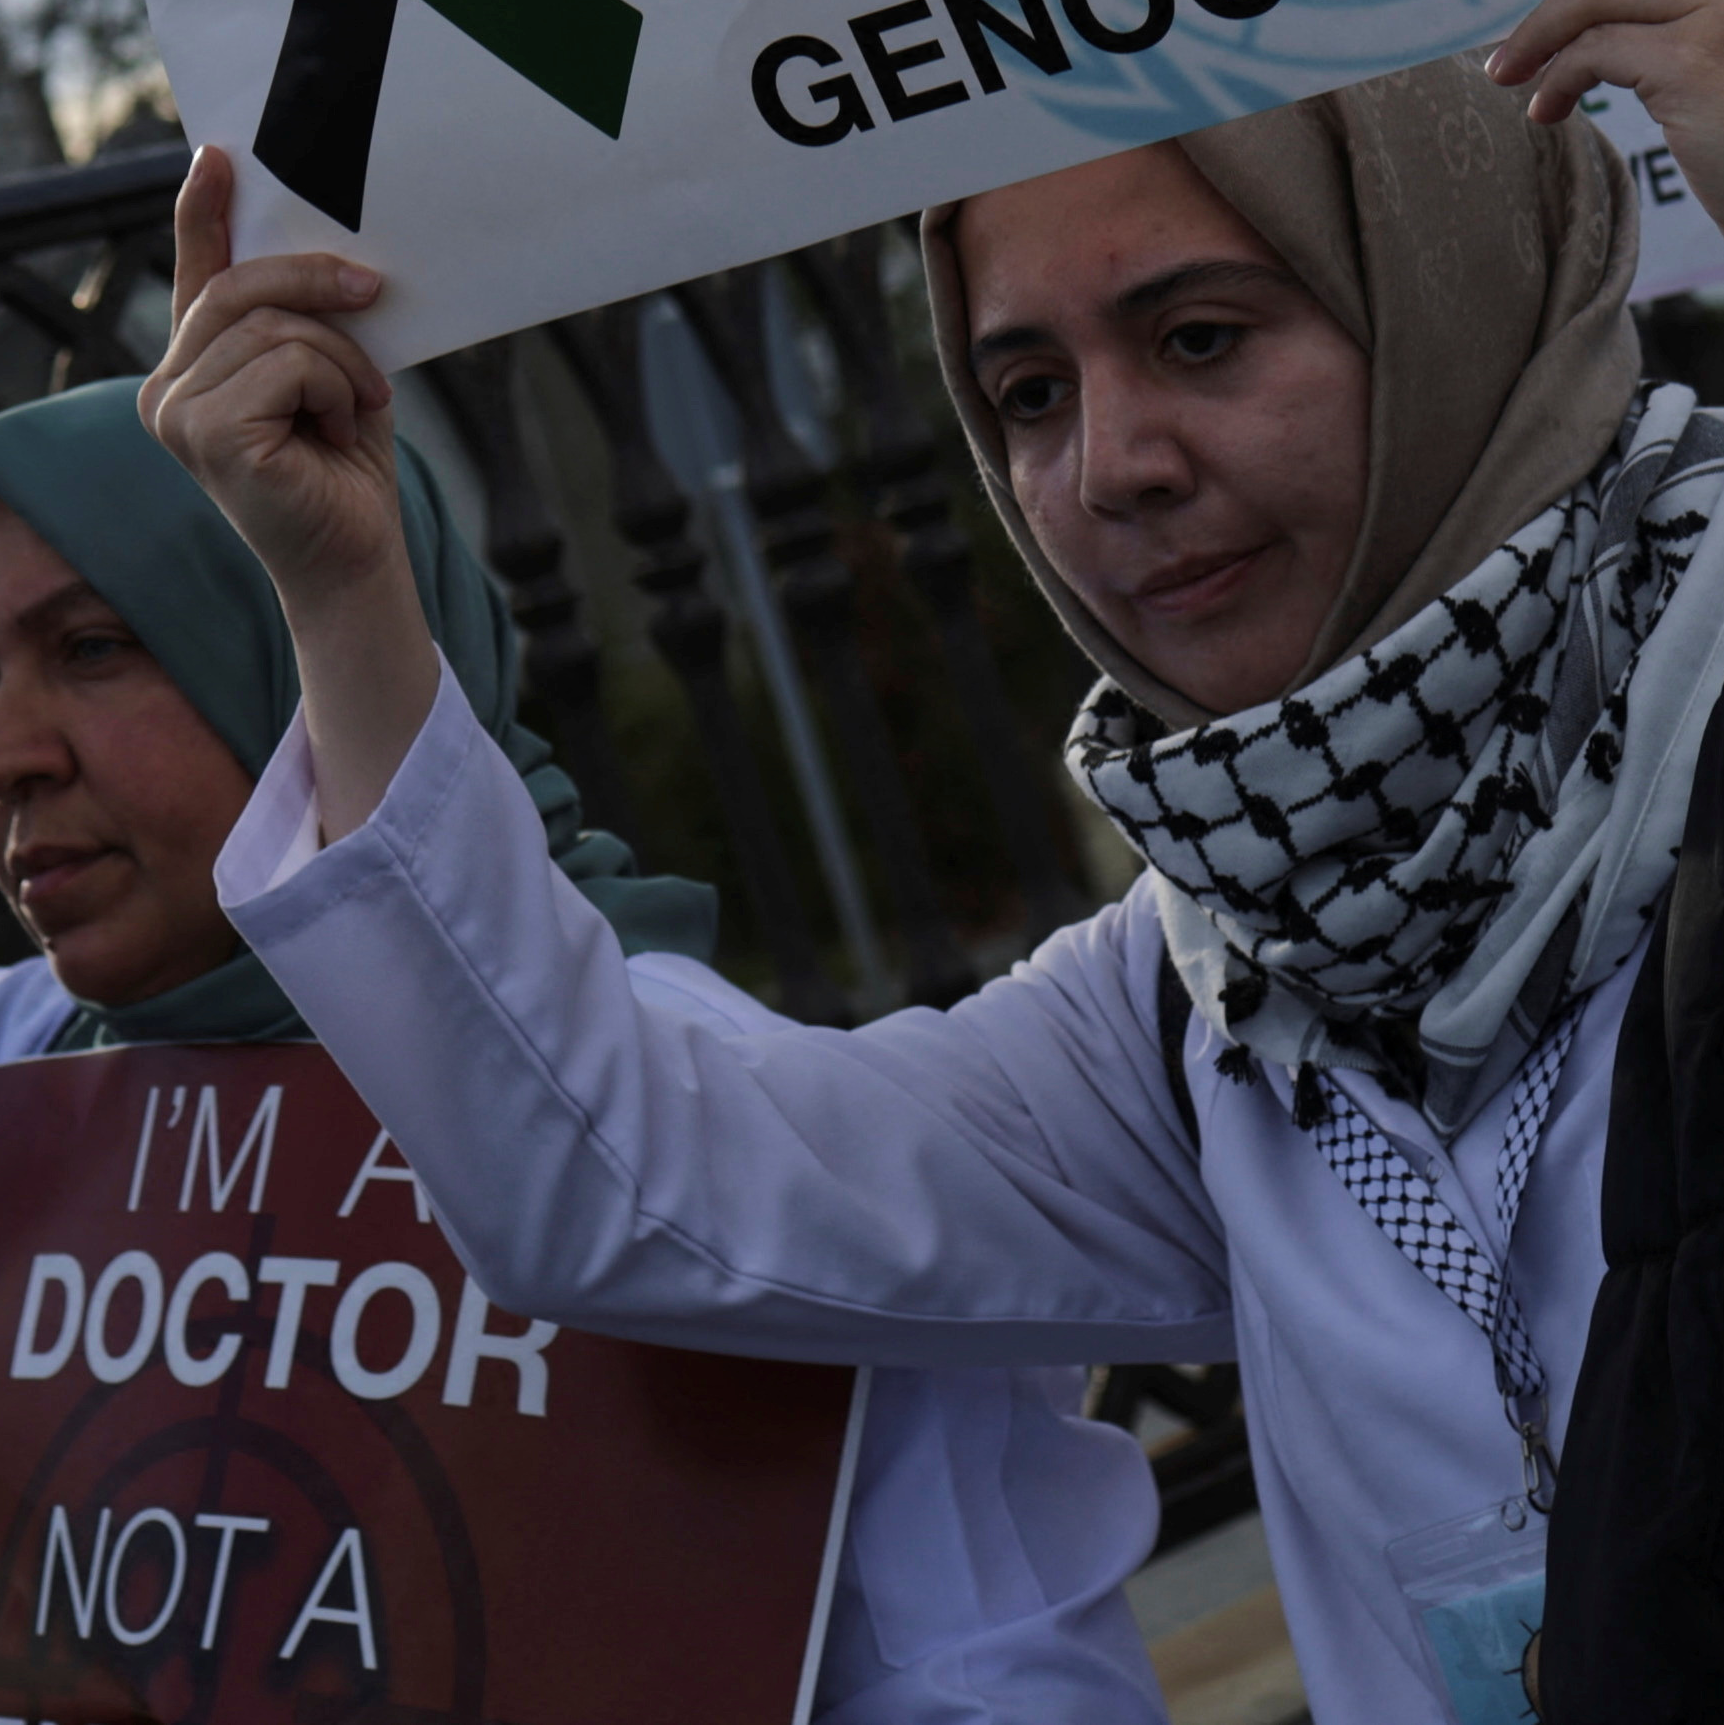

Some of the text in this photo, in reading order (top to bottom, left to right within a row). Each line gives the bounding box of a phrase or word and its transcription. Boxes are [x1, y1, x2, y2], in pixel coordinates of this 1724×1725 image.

[127, 1085, 283, 1214] I'M
[9, 1250, 559, 1417] DOCTOR
[36, 1505, 377, 1671] NOT A
